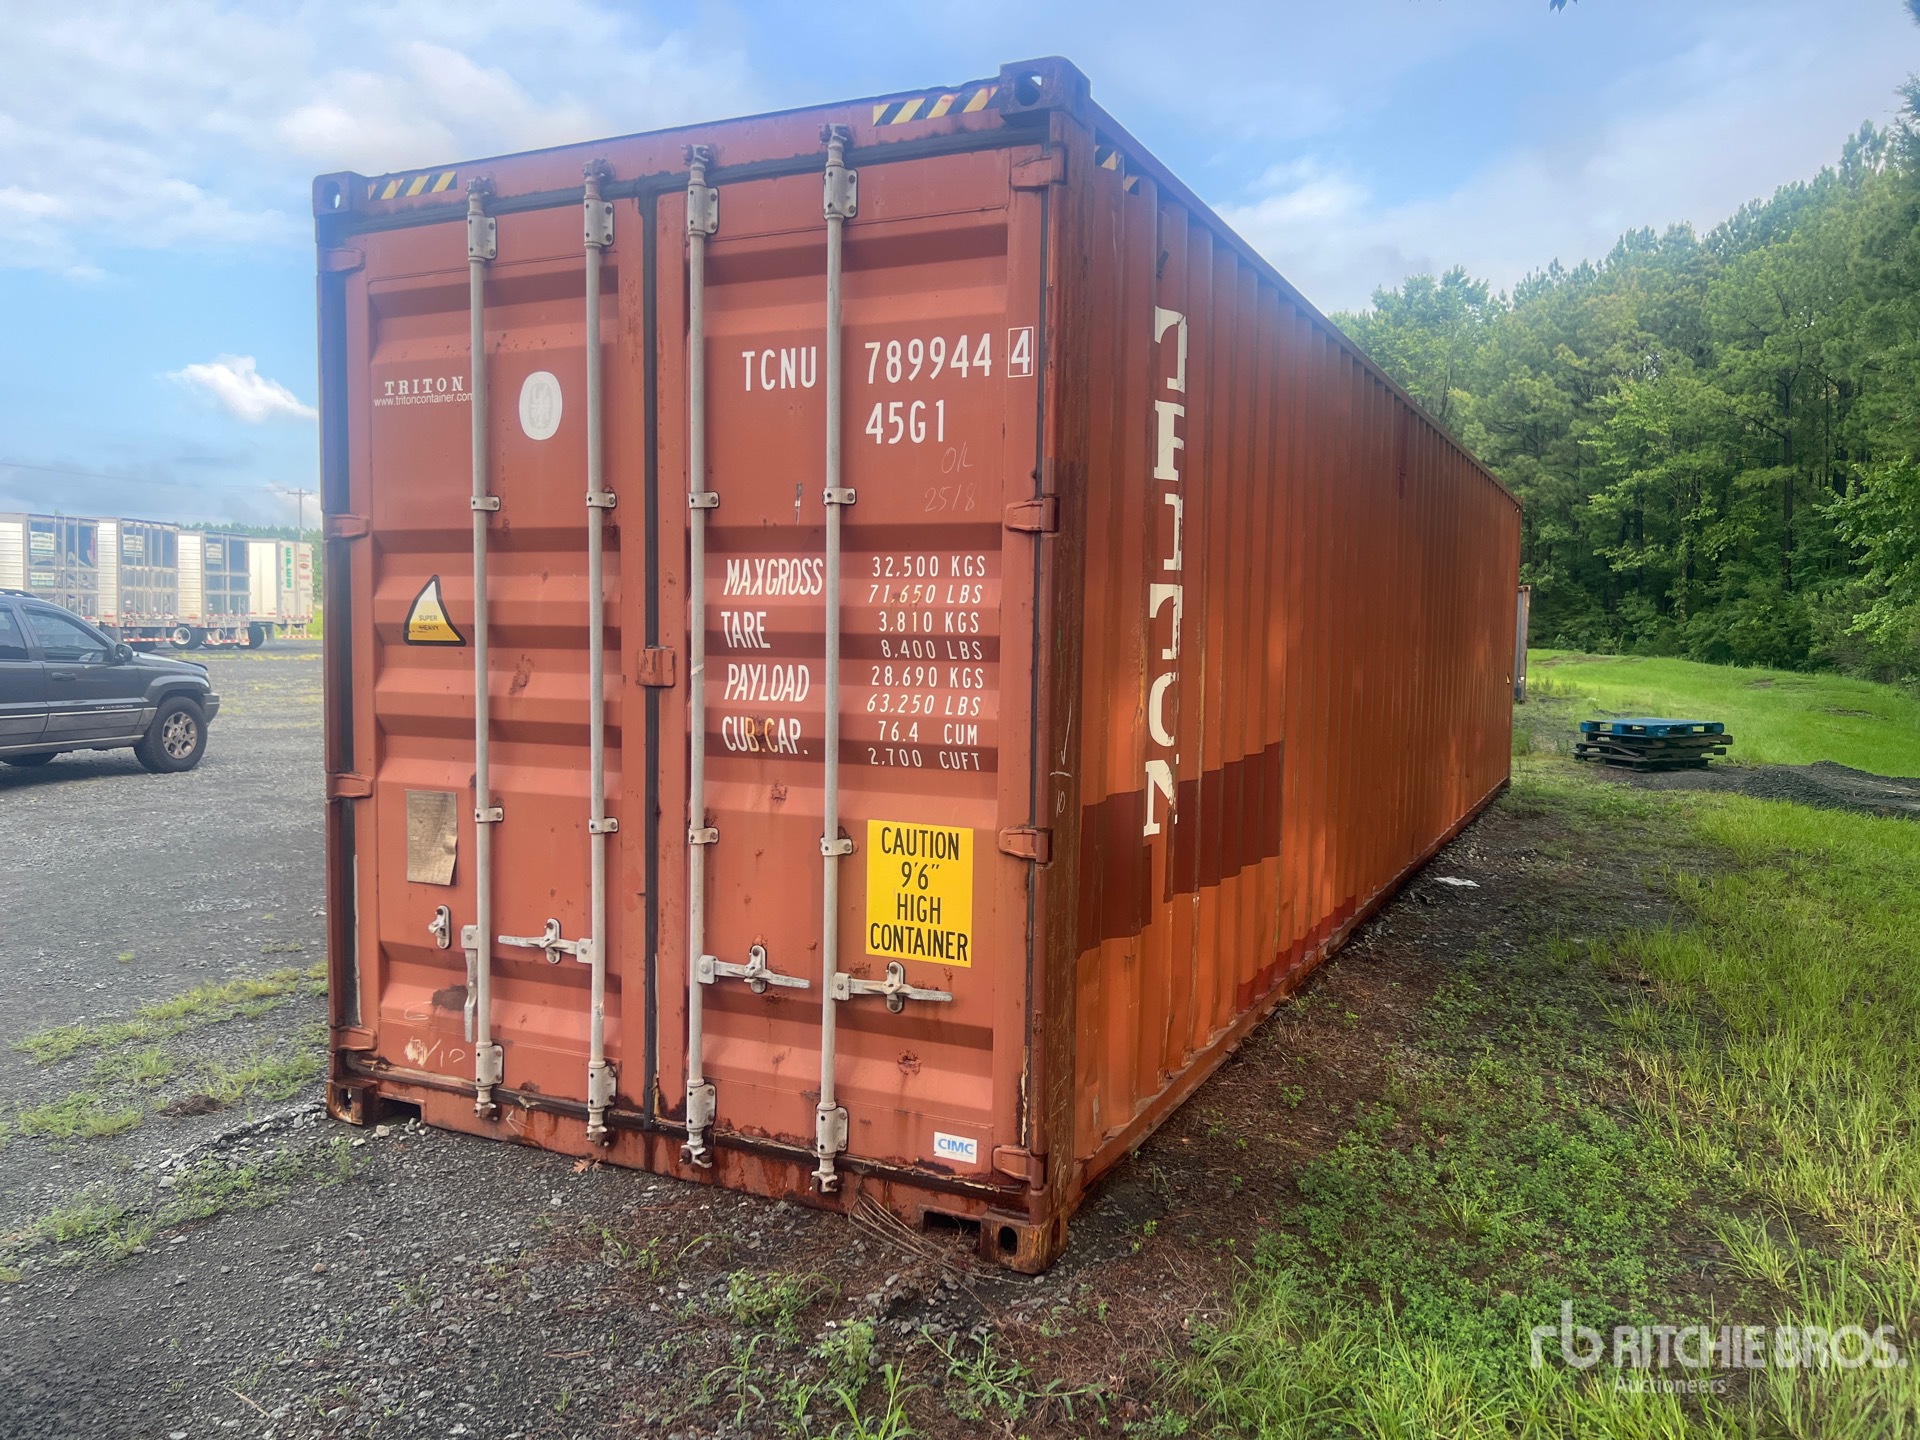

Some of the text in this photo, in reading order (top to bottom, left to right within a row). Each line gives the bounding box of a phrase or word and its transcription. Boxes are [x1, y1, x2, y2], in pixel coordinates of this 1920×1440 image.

[741, 329, 1031, 392] TCNU 789944 4
[384, 375, 464, 396] TRITON
[865, 399, 945, 444] 45G1
[872, 556, 939, 577] 32,500
[951, 555, 986, 577] KGS
[868, 584, 983, 604] 71,650 LBS
[418, 614, 438, 622] SUPER
[721, 611, 979, 649] TARE 3,810 KGS
[881, 639, 983, 660] 8,400 LBS
[724, 663, 984, 702] PAYLOAD 28,690 KGS
[866, 693, 981, 716] 63,250 LBS
[878, 720, 919, 743] 76.4
[943, 723, 978, 745] CUM
[868, 747, 980, 771] 2,700 CUFT
[881, 826, 960, 861] CAUTION
[897, 892, 941, 925] HIGH
[870, 922, 969, 962] CONTAINER
[938, 1138, 974, 1155] CIMC
